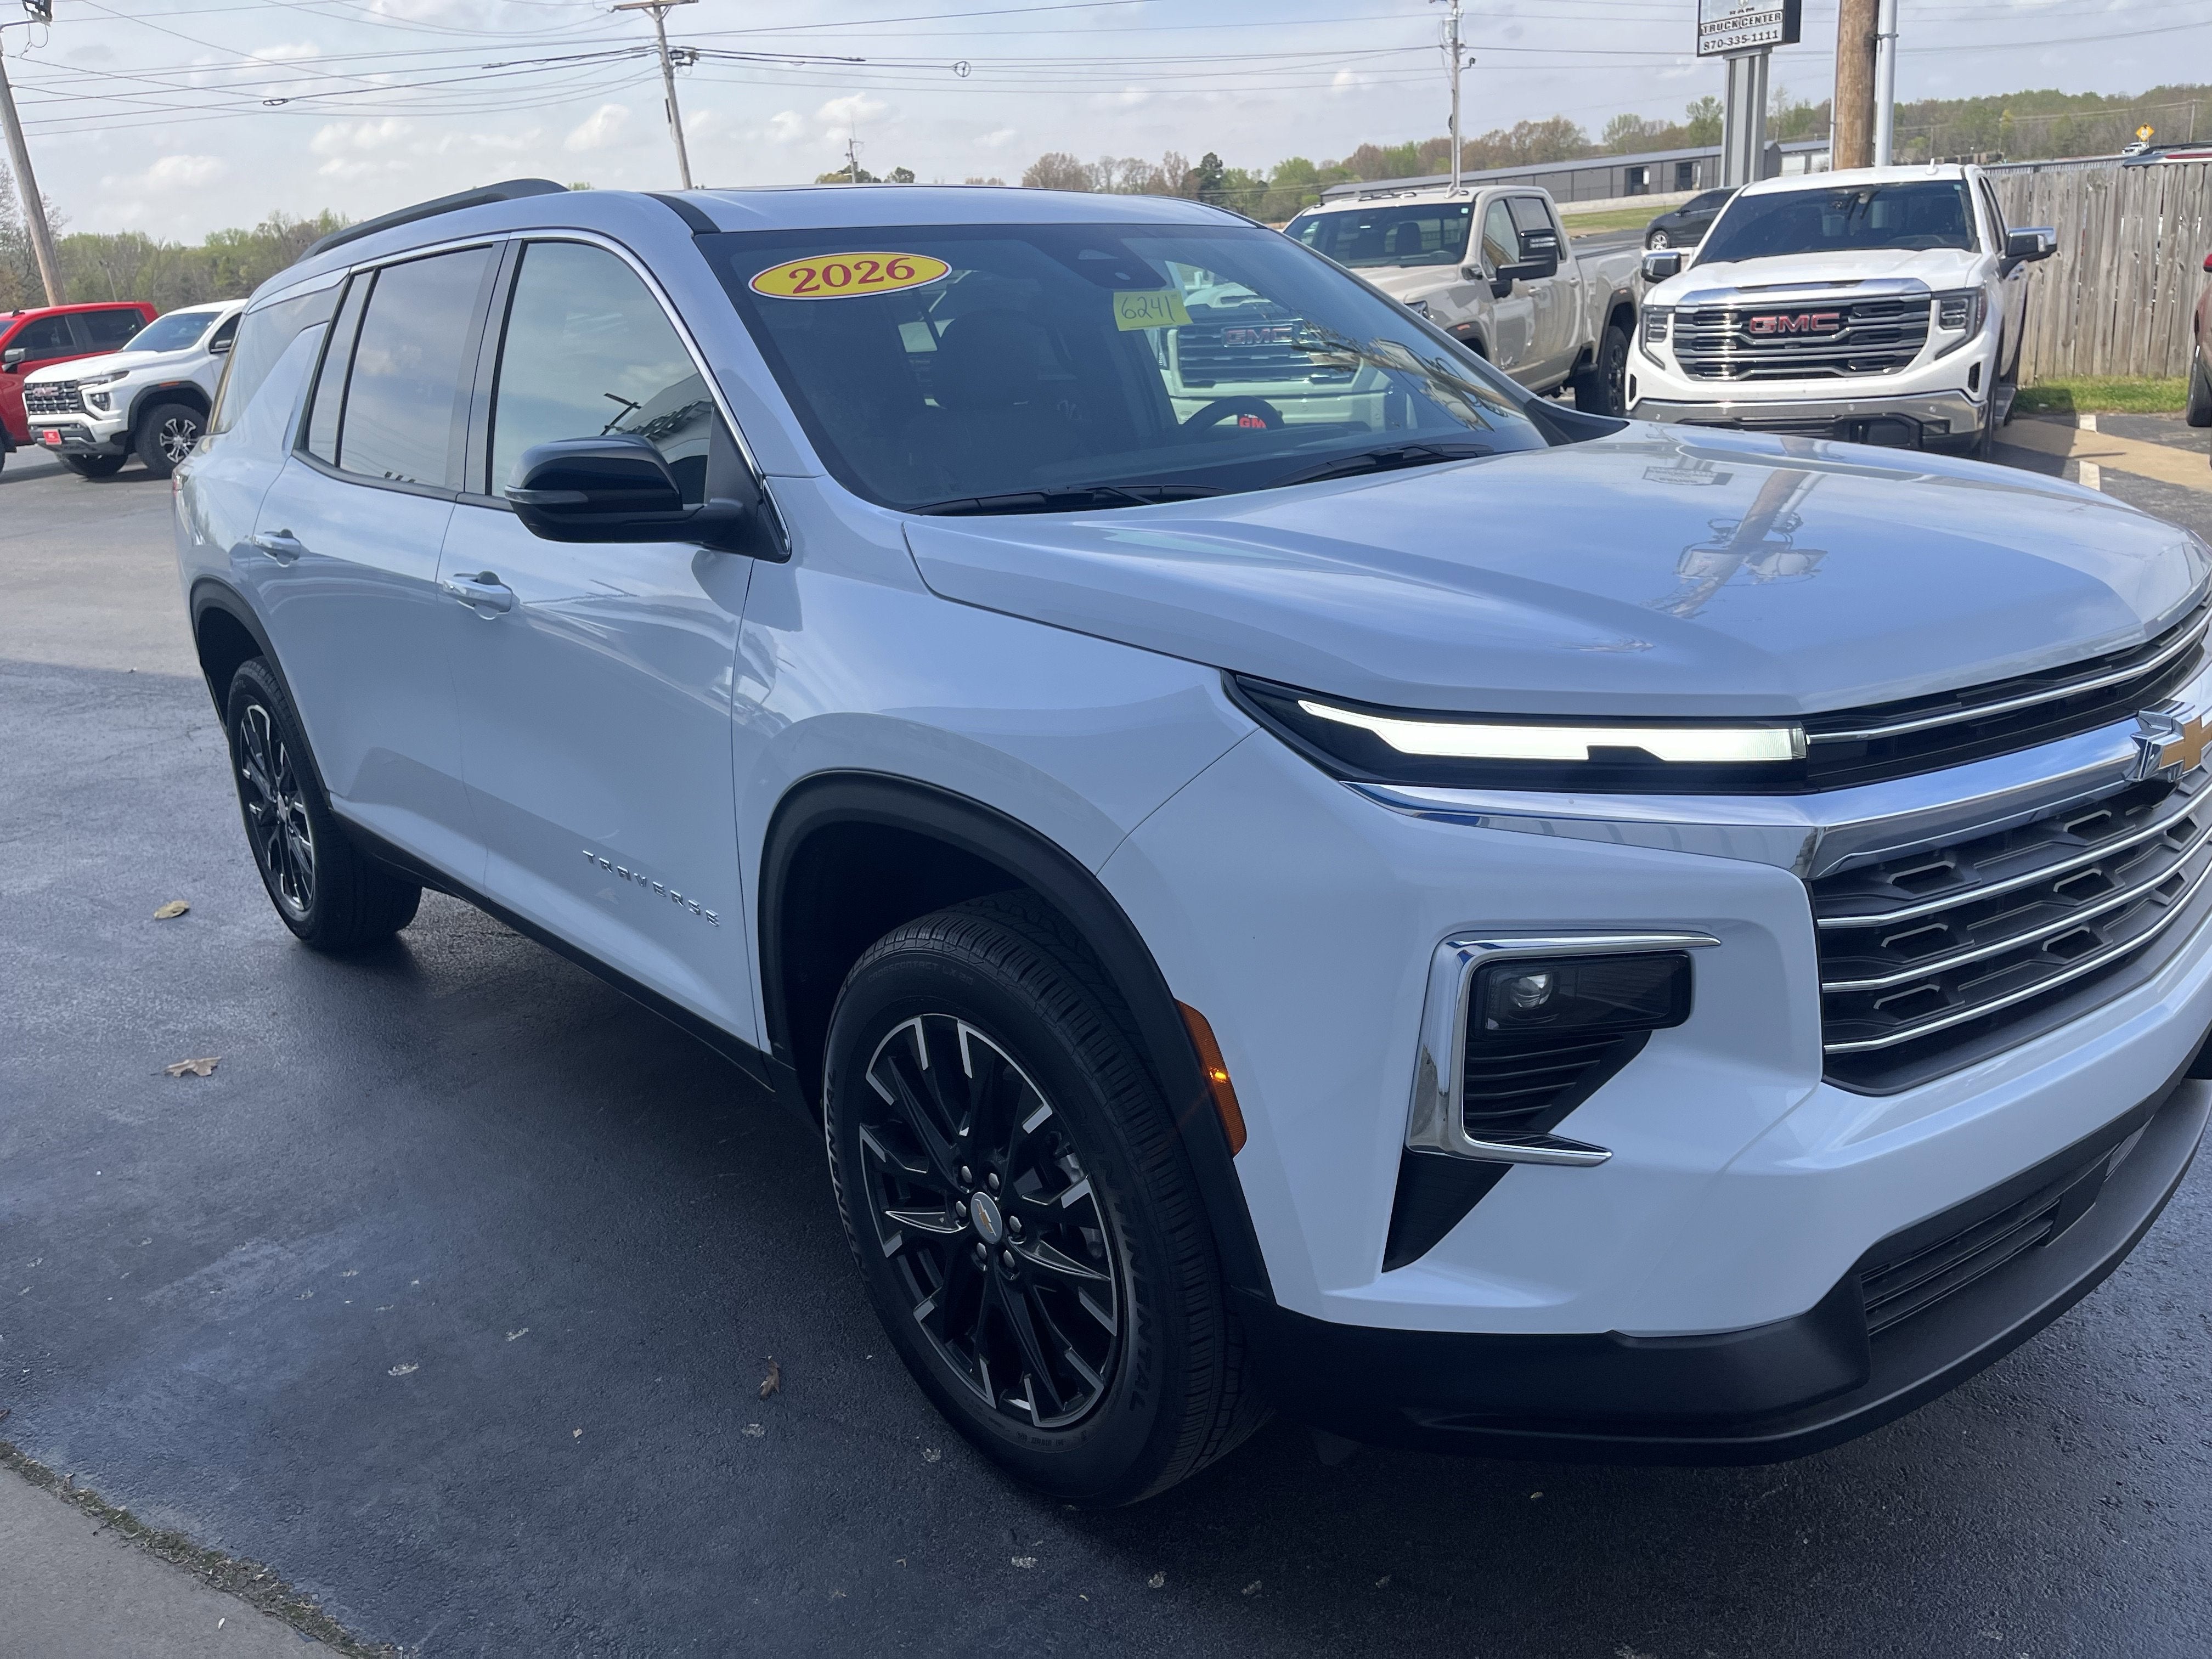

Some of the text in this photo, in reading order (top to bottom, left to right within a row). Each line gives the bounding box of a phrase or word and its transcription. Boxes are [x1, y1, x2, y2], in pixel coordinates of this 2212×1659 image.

[1703, 12, 1781, 34] TRUCK CENTER
[1703, 30, 1778, 51] 870-335-1111
[789, 257, 915, 294] 2026
[1121, 296, 1176, 323] 6241
[1749, 313, 1840, 334] GMC
[1227, 327, 1293, 345] GMC
[582, 850, 720, 927] TRAVERSE
[867, 960, 939, 983] CROSSCONTACT
